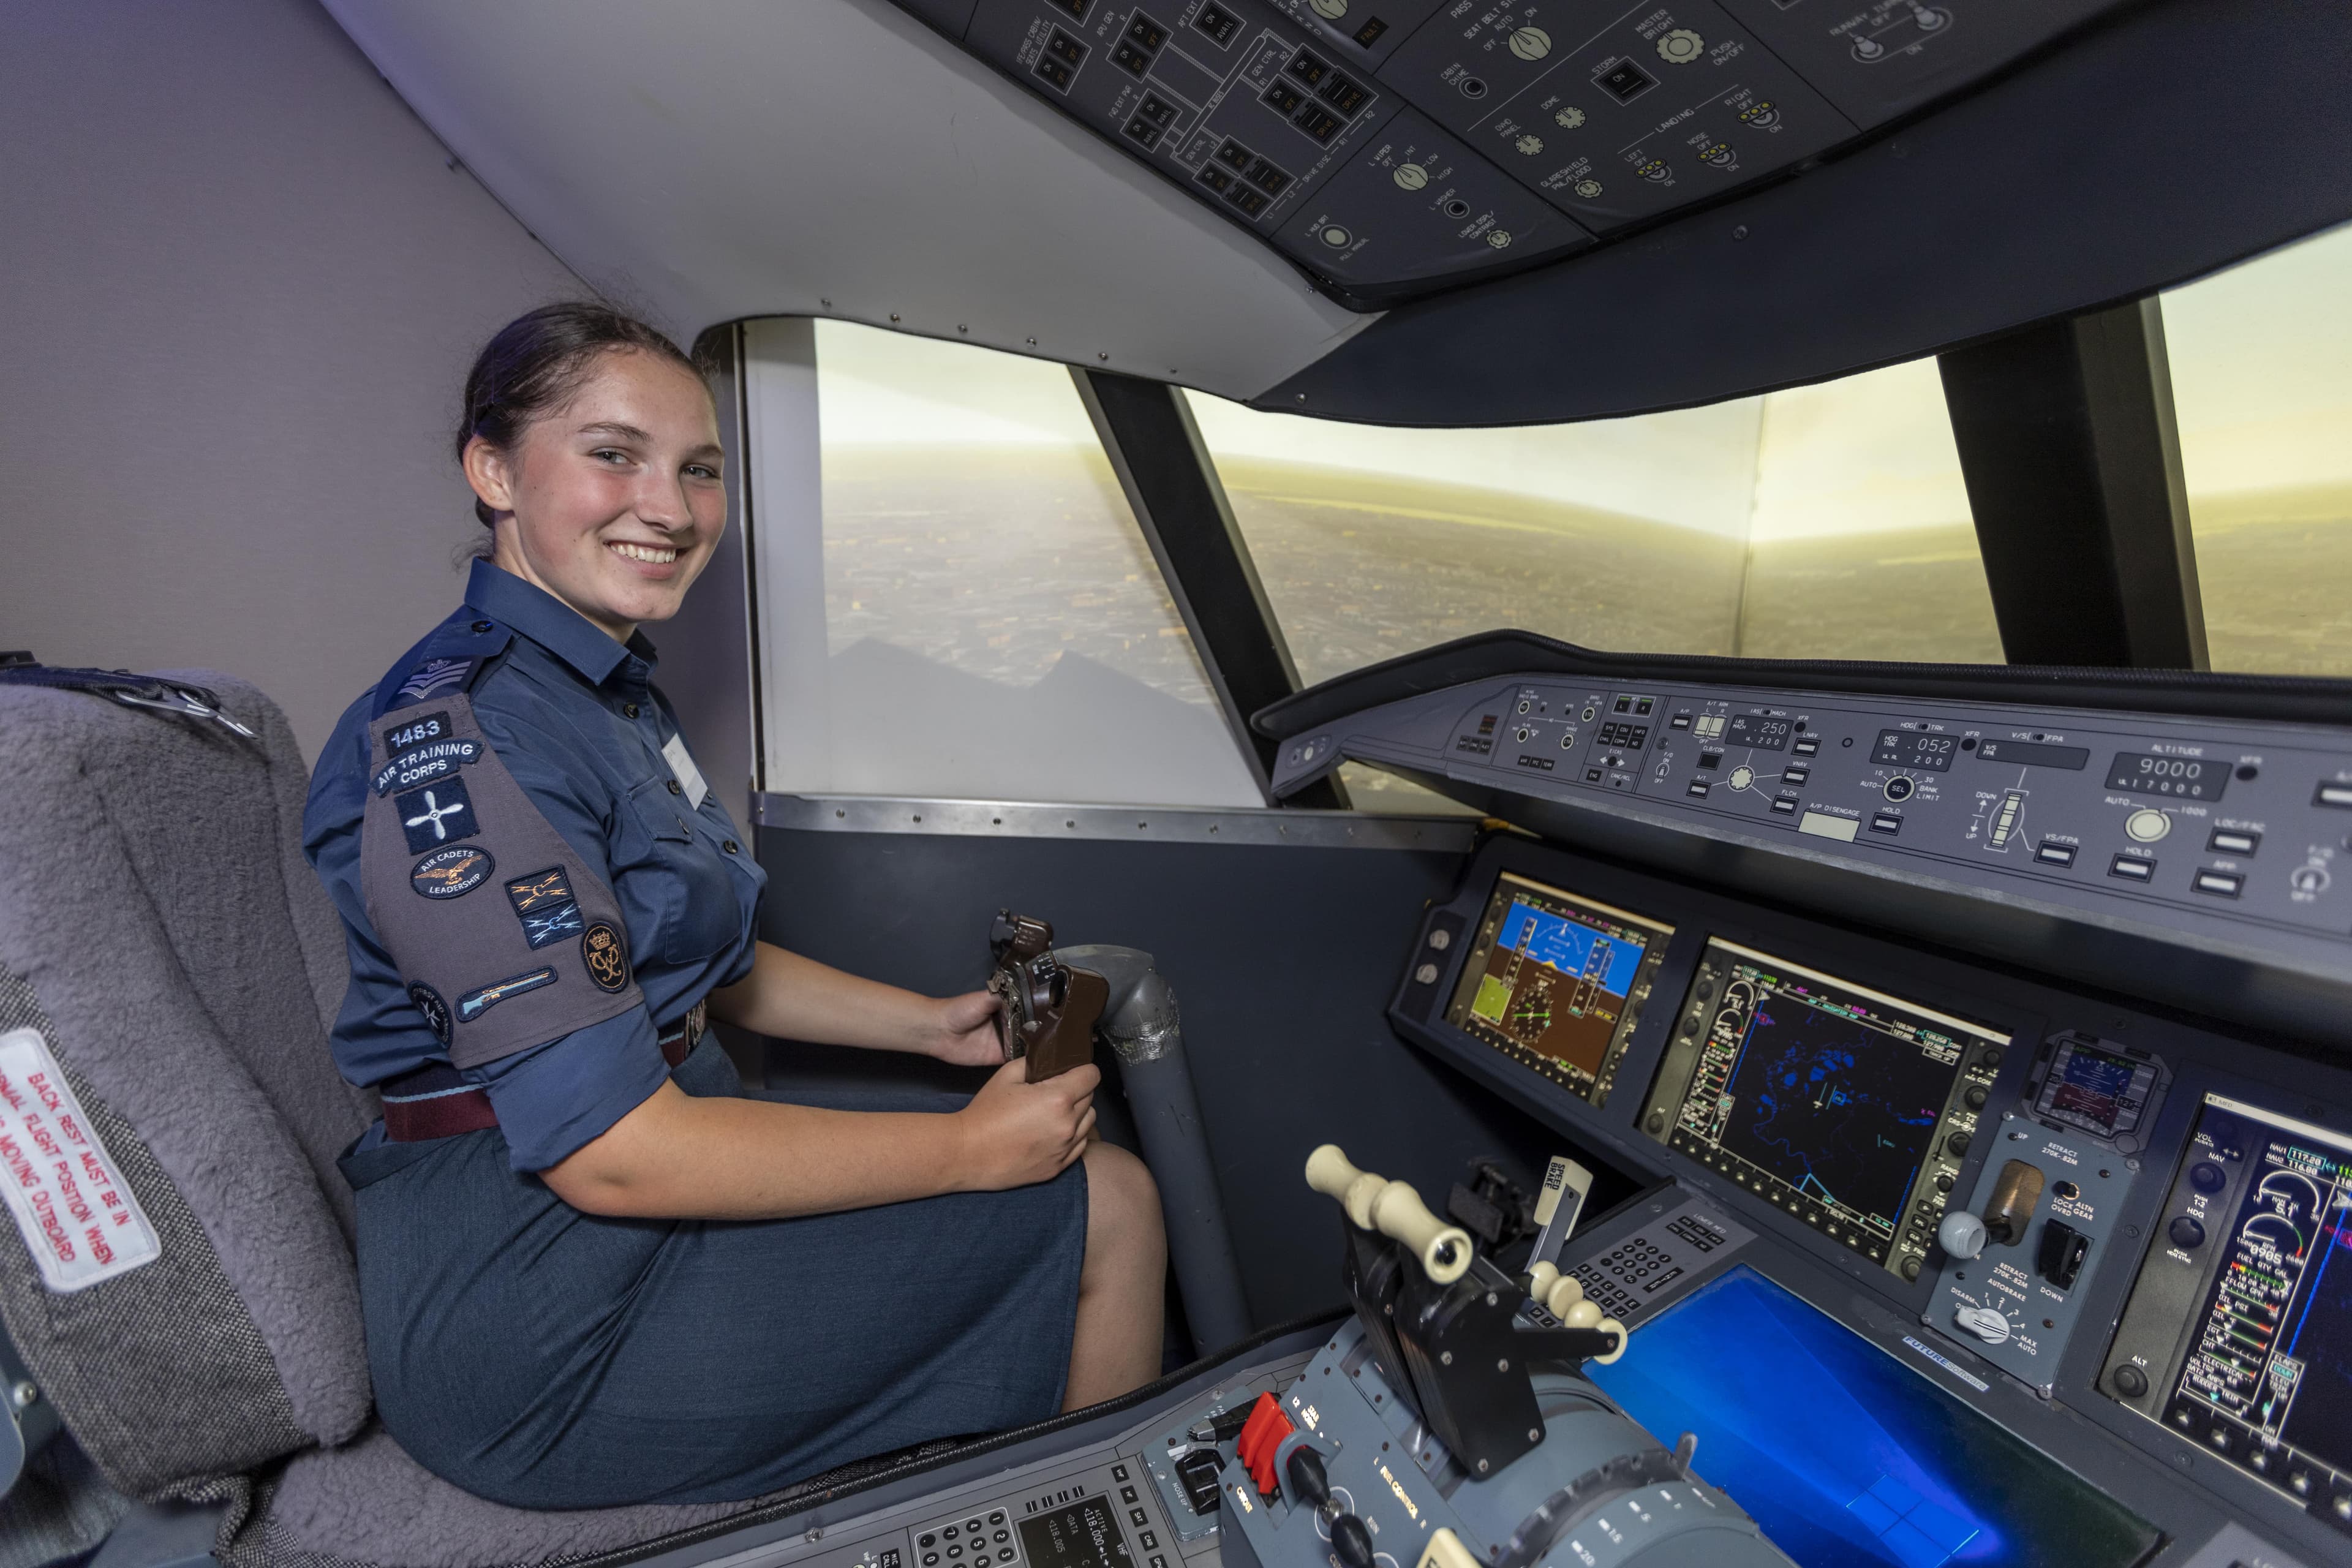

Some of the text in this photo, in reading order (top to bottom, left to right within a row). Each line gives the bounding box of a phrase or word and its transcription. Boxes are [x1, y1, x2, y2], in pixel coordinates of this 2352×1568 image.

[1205, 13, 1215, 24] ON
[1525, 7, 1538, 18] ON
[1463, 7, 1501, 39] SEAT BELT
[1494, 14, 1513, 32] AUTO
[1635, 9, 1668, 33] MASTER
[1643, 16, 1675, 40] BRIGHT
[1216, 22, 1233, 40] AVAIL
[1483, 39, 1496, 51] OFF
[1710, 40, 1735, 57] PUSH
[1713, 43, 1746, 66] ON/OFF
[1441, 62, 1461, 80] CABIN
[1591, 56, 1618, 75] STORM
[1449, 68, 1469, 86] CHIME
[1613, 73, 1625, 83] ON
[1342, 92, 1361, 110] DRIVE
[1540, 95, 1561, 111] DOME
[1724, 88, 1752, 107] RIGHT
[1738, 98, 1754, 110] OFF
[1317, 119, 1334, 137] DRIVE
[1655, 108, 1695, 133] LANDING
[1500, 124, 1521, 138] PANEL
[1770, 124, 1782, 134] ON
[1686, 132, 1709, 146] NOSE
[1697, 140, 1712, 151] OFF
[1373, 145, 1392, 161] WIPER
[1404, 145, 1416, 156] INT
[1624, 149, 1643, 162] LEFT
[1382, 156, 1393, 167] OFF
[1426, 153, 1439, 165] LOW
[1634, 156, 1648, 167] OFF
[1437, 166, 1454, 181] HIGH
[1540, 157, 1588, 187] GLARESHIELD
[1727, 163, 1740, 172] ON
[1435, 188, 1456, 205] WASHER
[1458, 224, 1477, 238] LOWER
[1469, 218, 1496, 239] CONTRAST
[391, 720, 440, 748] 1483
[2151, 744, 2204, 756] ALTITUDE
[378, 744, 473, 789] AIR TRAINING
[401, 760, 448, 783] CORPS
[2139, 758, 2201, 778] 9000
[1975, 791, 1997, 800] DOWN
[2105, 796, 2130, 806] AUTO
[1824, 805, 1860, 816] DISENGAGE
[2045, 833, 2079, 845] VS/FPA
[2125, 846, 2153, 857] HOLD
[421, 850, 474, 872] AIR CADETS
[429, 873, 481, 894] LEADERSHIP
[1977, 1077, 1992, 1087] COM
[2197, 1132, 2212, 1142] VOL
[28, 1072, 132, 1227] BACK REST MUST BE IN
[2048, 1142, 2078, 1158] RETRACT
[2208, 1152, 2225, 1163] NAV
[1545, 1163, 1558, 1189] BRAKE
[1552, 1164, 1565, 1190] SPEED
[23, 1112, 63, 1156] FLIGHT
[53, 1161, 96, 1223] POSITION
[85, 1223, 116, 1265] WHEN
[2051, 1204, 2072, 1217] OVRD
[2053, 1197, 2074, 1210] LOCK
[2075, 1201, 2094, 1213] ALTN
[2073, 1207, 2094, 1221] GEAR
[2187, 1207, 2205, 1218] HDG
[32, 1191, 76, 1263] OUTBOARD
[1999, 1262, 2029, 1280] RETRACT
[2237, 1252, 2253, 1265] FUEL
[2274, 1268, 2288, 1279] GAL
[1951, 1287, 1975, 1304] DISARM
[1987, 1278, 2027, 1302] AUTOBRAKE
[2040, 1286, 2064, 1303] DOWN
[2218, 1294, 2248, 1313] OIL PSI
[2212, 1310, 2225, 1321] OIL
[2207, 1325, 2220, 1336] EGT
[2017, 1342, 2037, 1356] AUTO
[2019, 1335, 2038, 1348] MAX
[2202, 1338, 2215, 1349] CHT
[2132, 1354, 2148, 1367] ALT
[2192, 1374, 2218, 1392] RUDDER
[1172, 1482, 1184, 1499] NOSE
[1094, 1509, 1108, 1534] ACTIVE
[1134, 1512, 1144, 1522] SAT
[1144, 1535, 1153, 1547] CAB
[1608, 1527, 1623, 1544] 15
[1117, 1542, 1129, 1556] VHF
[1580, 1550, 1596, 1567] 20
